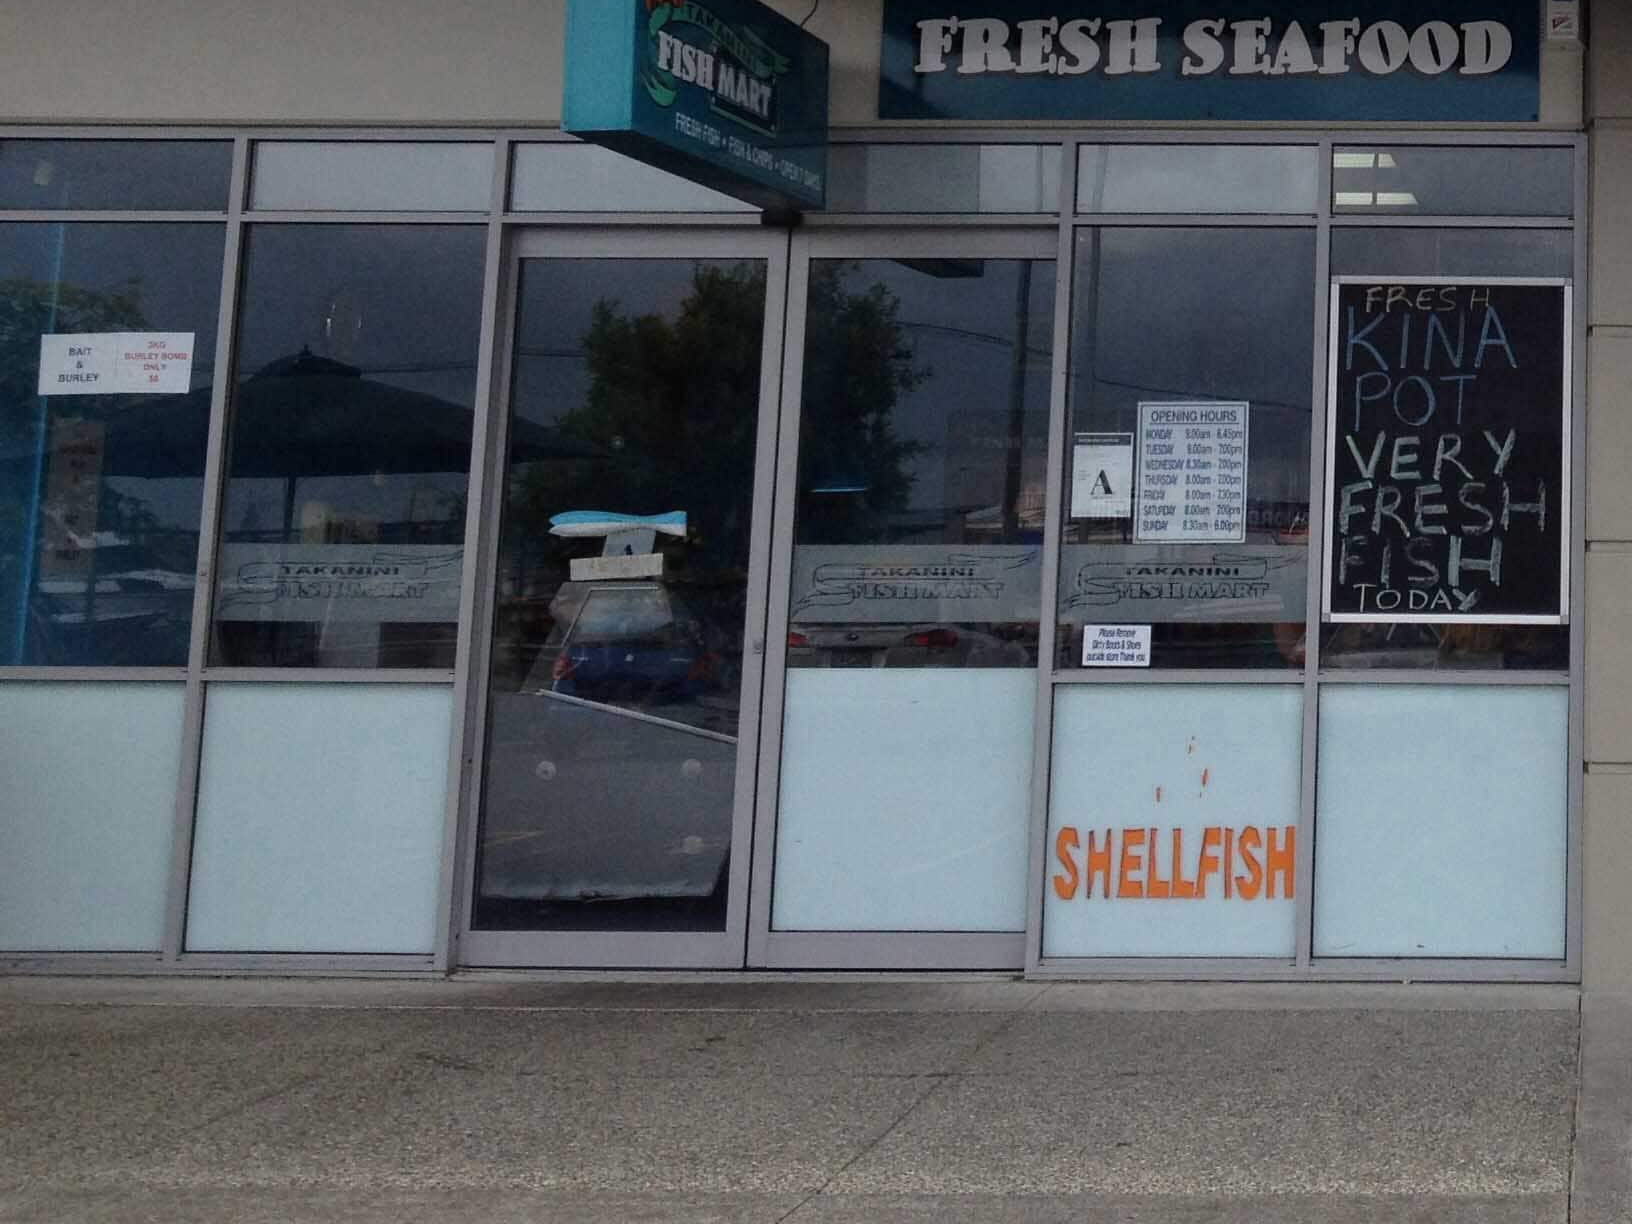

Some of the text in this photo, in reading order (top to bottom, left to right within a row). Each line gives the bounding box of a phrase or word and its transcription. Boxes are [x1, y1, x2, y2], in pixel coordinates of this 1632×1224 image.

[914, 15, 1513, 77] FRESH SEAFOOD
[657, 29, 773, 118] FISH MART
[1364, 286, 1491, 314] FRESH
[1344, 304, 1518, 371] KINA
[68, 347, 93, 357] BAIT
[57, 373, 100, 383] BURLEY
[1353, 372, 1478, 432] POT
[1151, 410, 1238, 423] OPENING HOURS
[1145, 443, 1175, 456] TUESDAY
[1345, 427, 1518, 482] VERY
[1090, 468, 1115, 496] A
[1145, 474, 1178, 486] THURSDAY
[1143, 489, 1166, 501] FRIDAY
[1143, 504, 1177, 517] SATURDAY
[1338, 477, 1547, 539] FRESH
[1142, 519, 1169, 532] SUNDAY
[1338, 534, 1503, 589] FISH
[280, 566, 400, 576] TAKANINI
[861, 567, 975, 577] TAKANINI
[1125, 567, 1241, 577] TAKANINI
[1187, 582, 1270, 599] MART
[1353, 582, 1481, 613] TODAY
[1052, 825, 1297, 902] SHELLFISH
